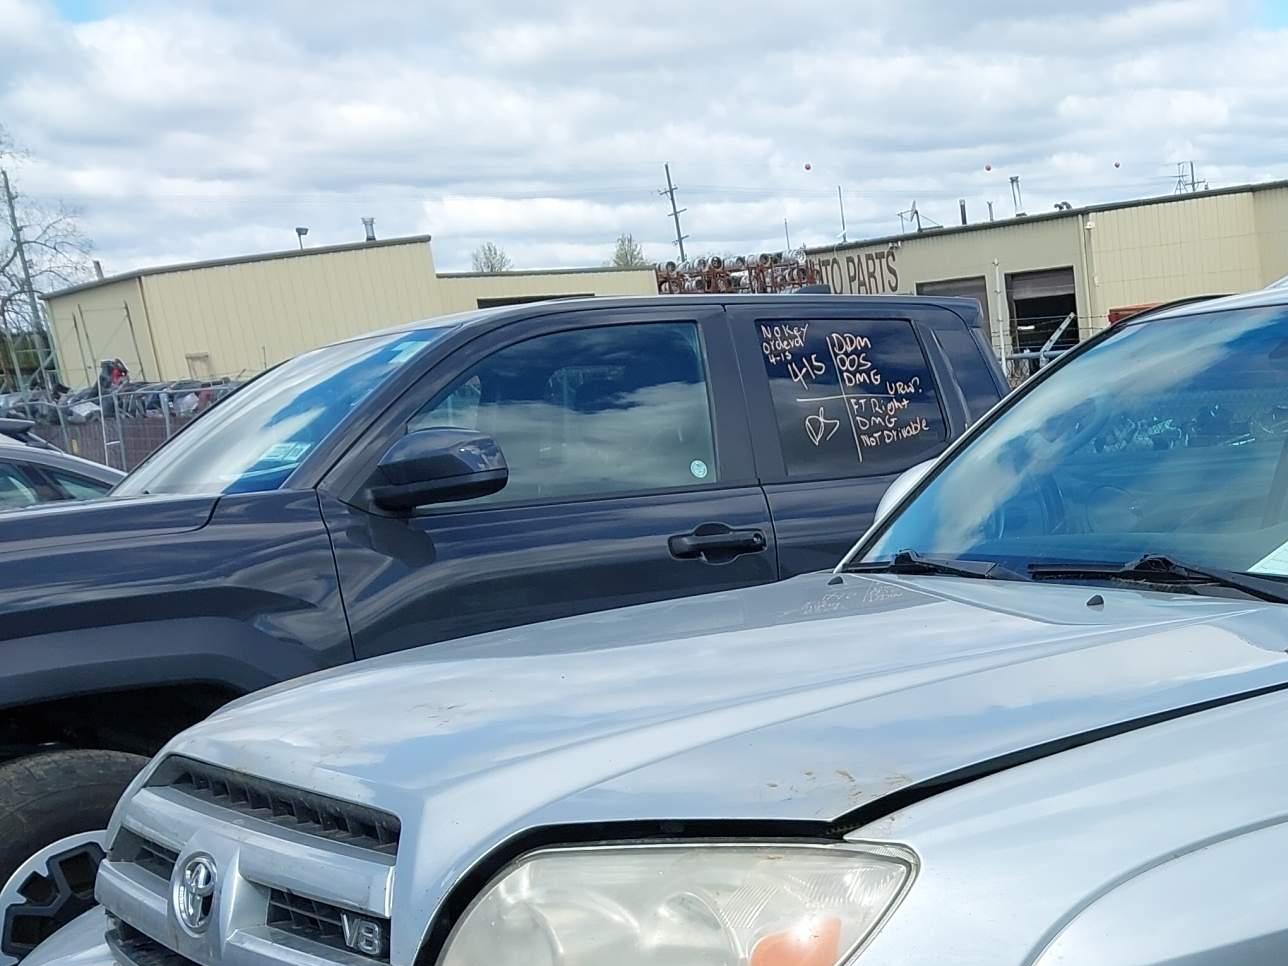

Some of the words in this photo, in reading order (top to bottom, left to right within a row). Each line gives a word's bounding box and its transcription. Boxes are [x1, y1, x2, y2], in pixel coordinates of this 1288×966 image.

[846, 250, 898, 294] PARTS
[843, 369, 881, 387] DMG
[871, 397, 910, 415] Right
[856, 415, 898, 430] DMG
[340, 913, 380, 955] V8
